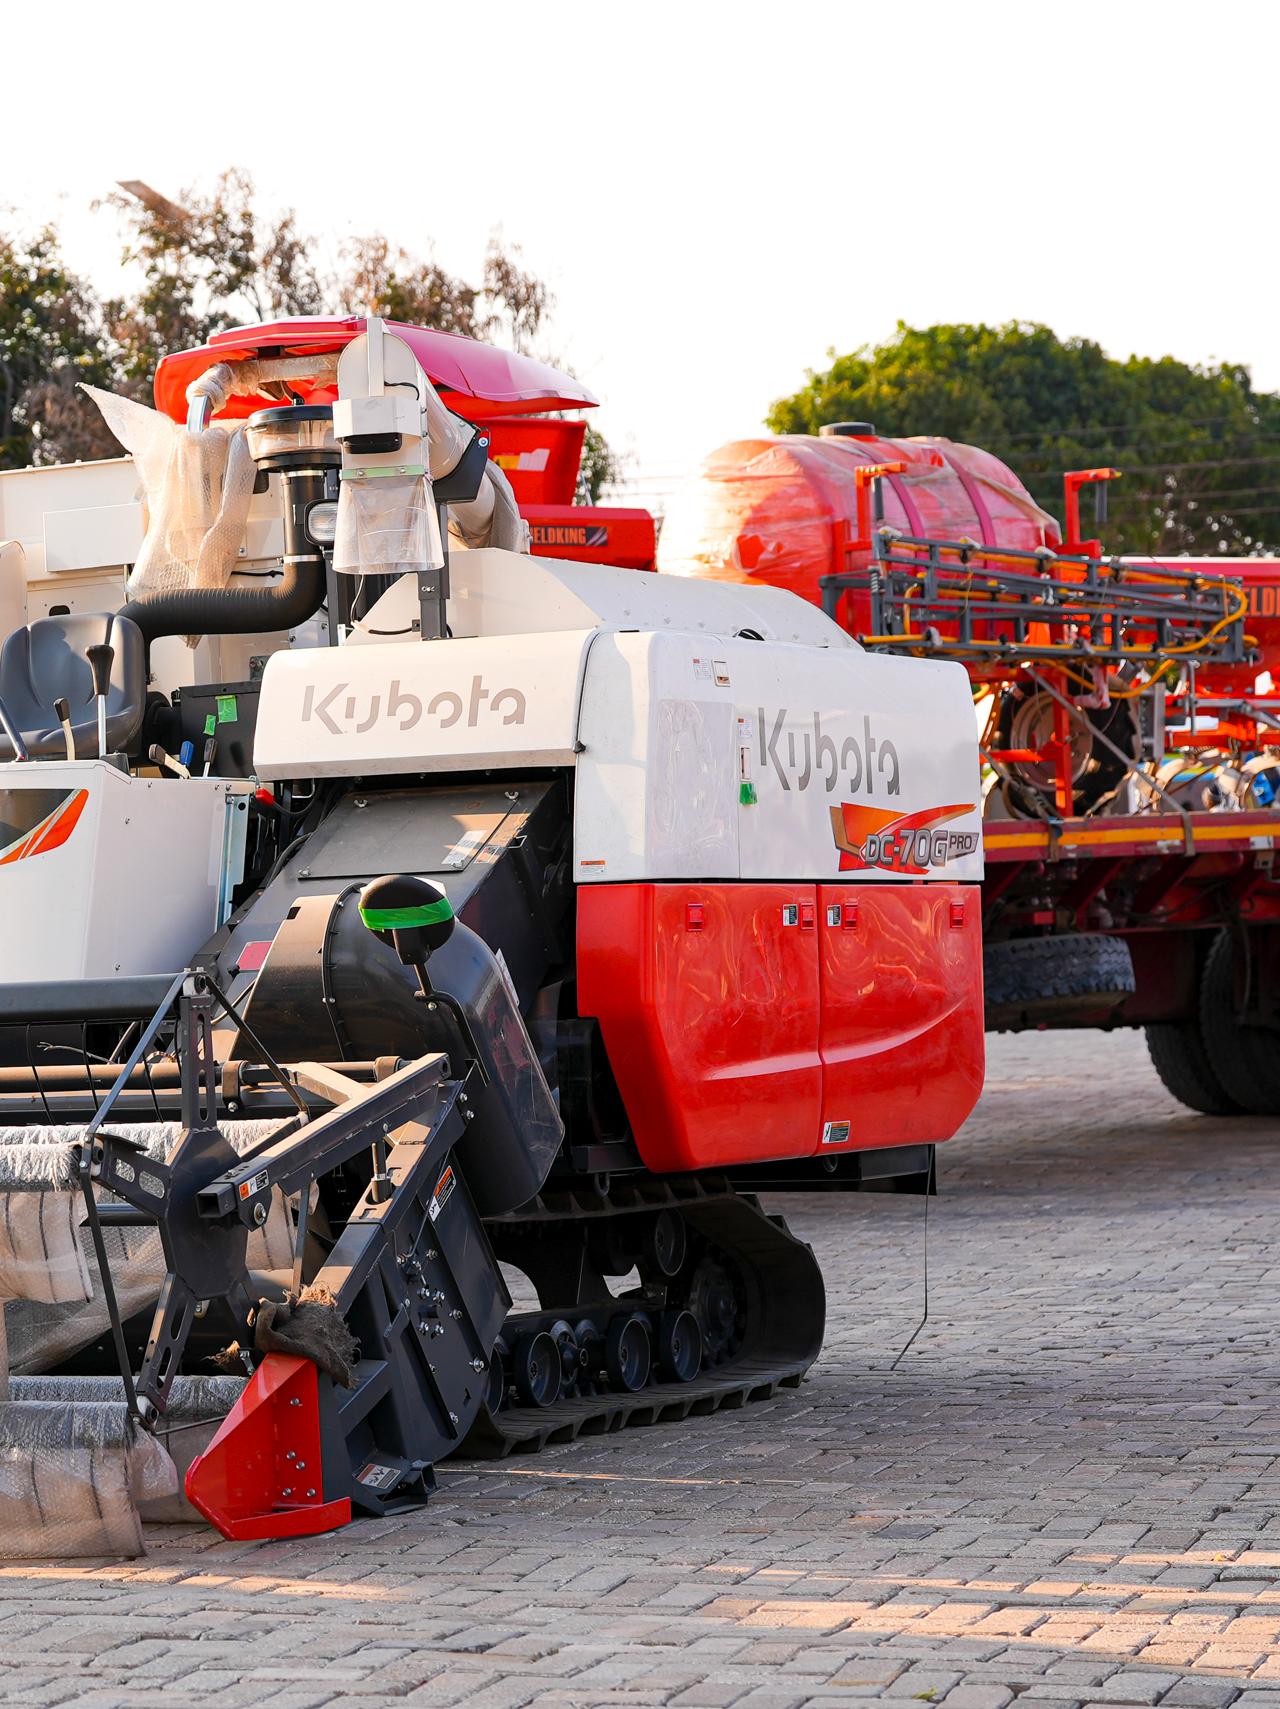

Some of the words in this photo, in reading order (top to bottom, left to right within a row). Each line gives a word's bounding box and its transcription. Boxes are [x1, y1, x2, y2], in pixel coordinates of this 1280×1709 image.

[301, 675, 526, 735] Kubota
[758, 707, 900, 796] Kubota
[864, 829, 948, 867] DC-70G
[949, 834, 973, 850] PRO
